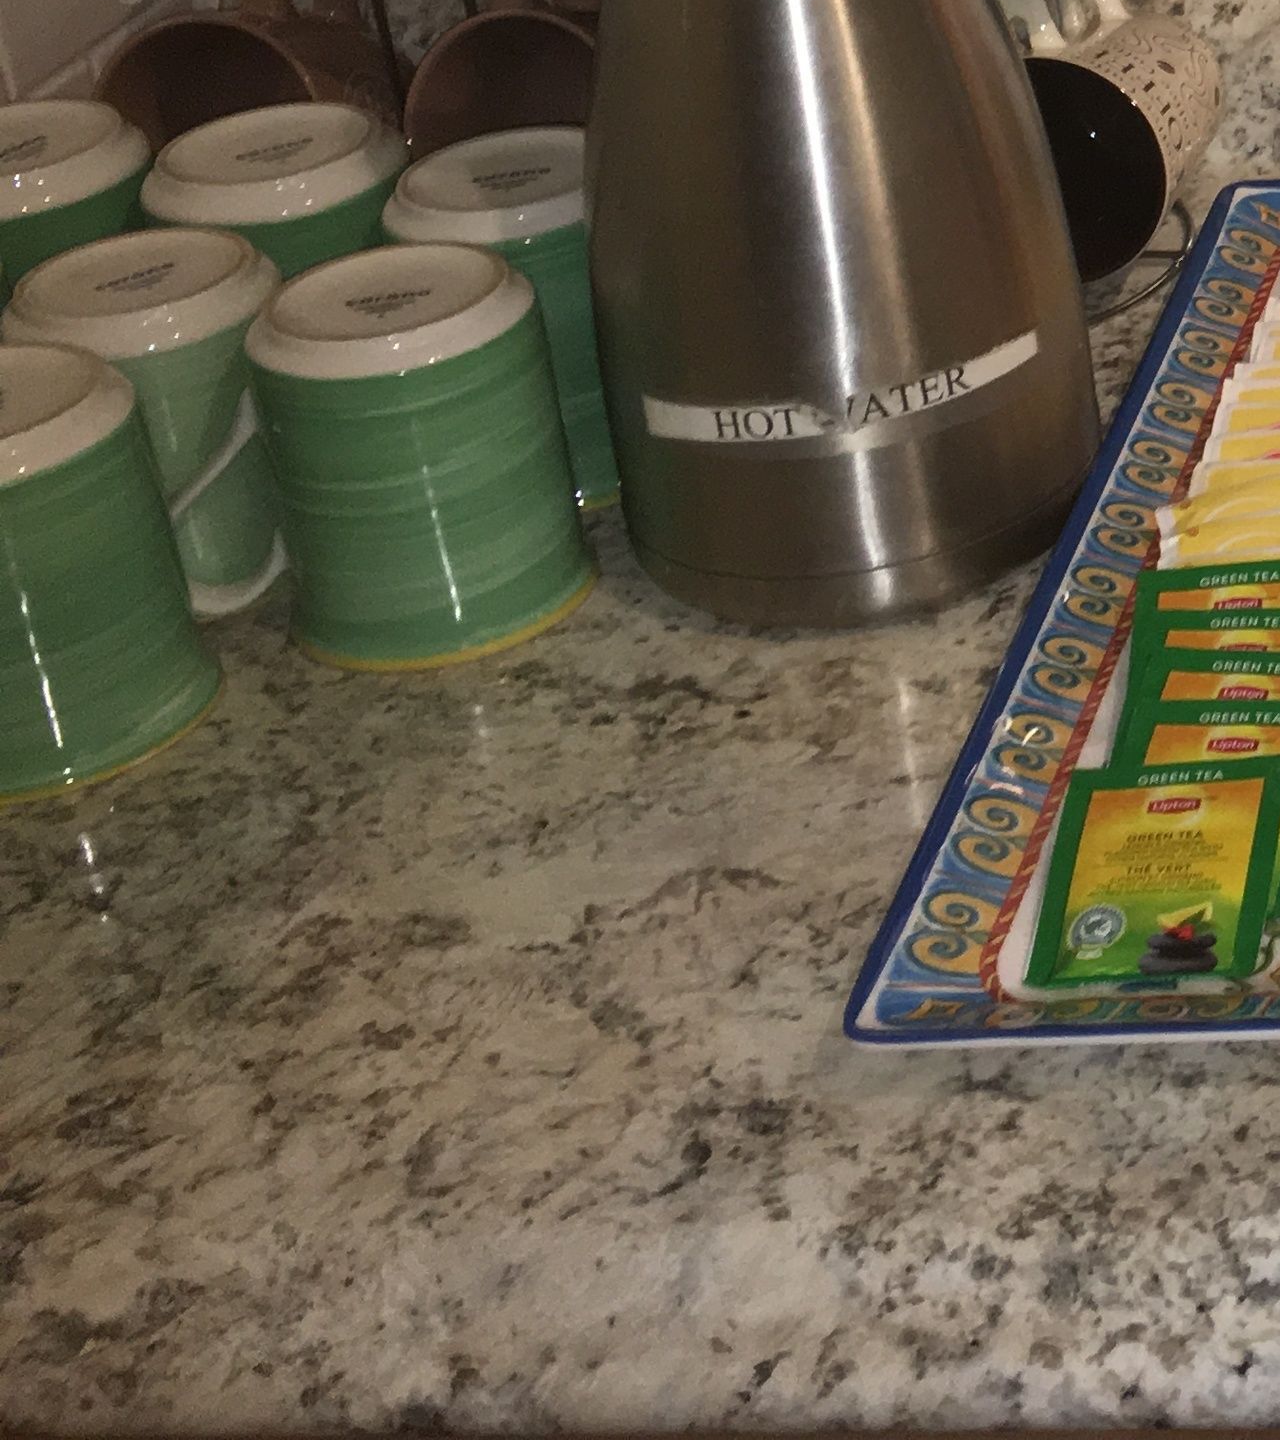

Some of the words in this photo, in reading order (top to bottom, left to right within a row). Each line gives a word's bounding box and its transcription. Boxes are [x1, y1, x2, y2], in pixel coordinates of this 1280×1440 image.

[713, 408, 797, 440] HOT
[1200, 572, 1249, 588] GREEN
[1253, 570, 1280, 582] TEA
[1210, 618, 1259, 629] GREEN
[1213, 660, 1262, 673] GREEN
[1222, 688, 1265, 699] Lipton
[1200, 711, 1250, 723] GREEN
[1211, 738, 1255, 751] Lipton
[1138, 771, 1191, 786] GREEN
[1195, 770, 1224, 781] TEA
[1151, 798, 1199, 812] Lipton
